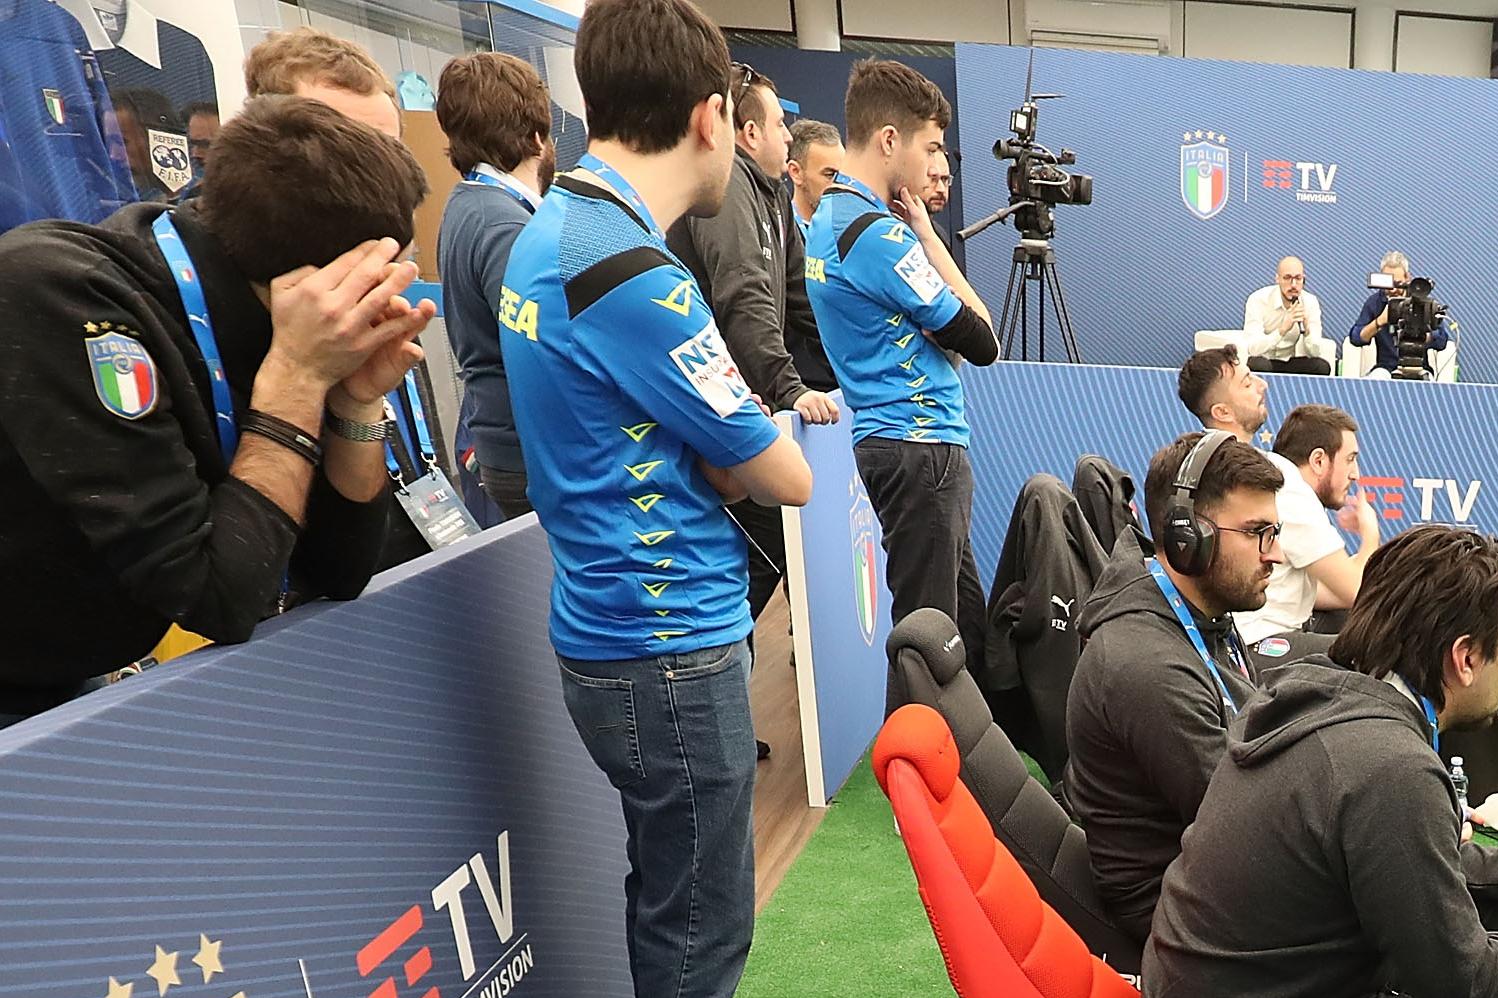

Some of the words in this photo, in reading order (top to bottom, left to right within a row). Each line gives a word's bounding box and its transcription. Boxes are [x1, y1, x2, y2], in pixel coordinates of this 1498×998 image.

[153, 134, 186, 146] REFEREE
[1185, 150, 1224, 162] ITALIA
[1296, 162, 1337, 191] TV
[93, 341, 142, 357] ITALIA
[1412, 478, 1482, 522] TV
[431, 830, 514, 982] TV
